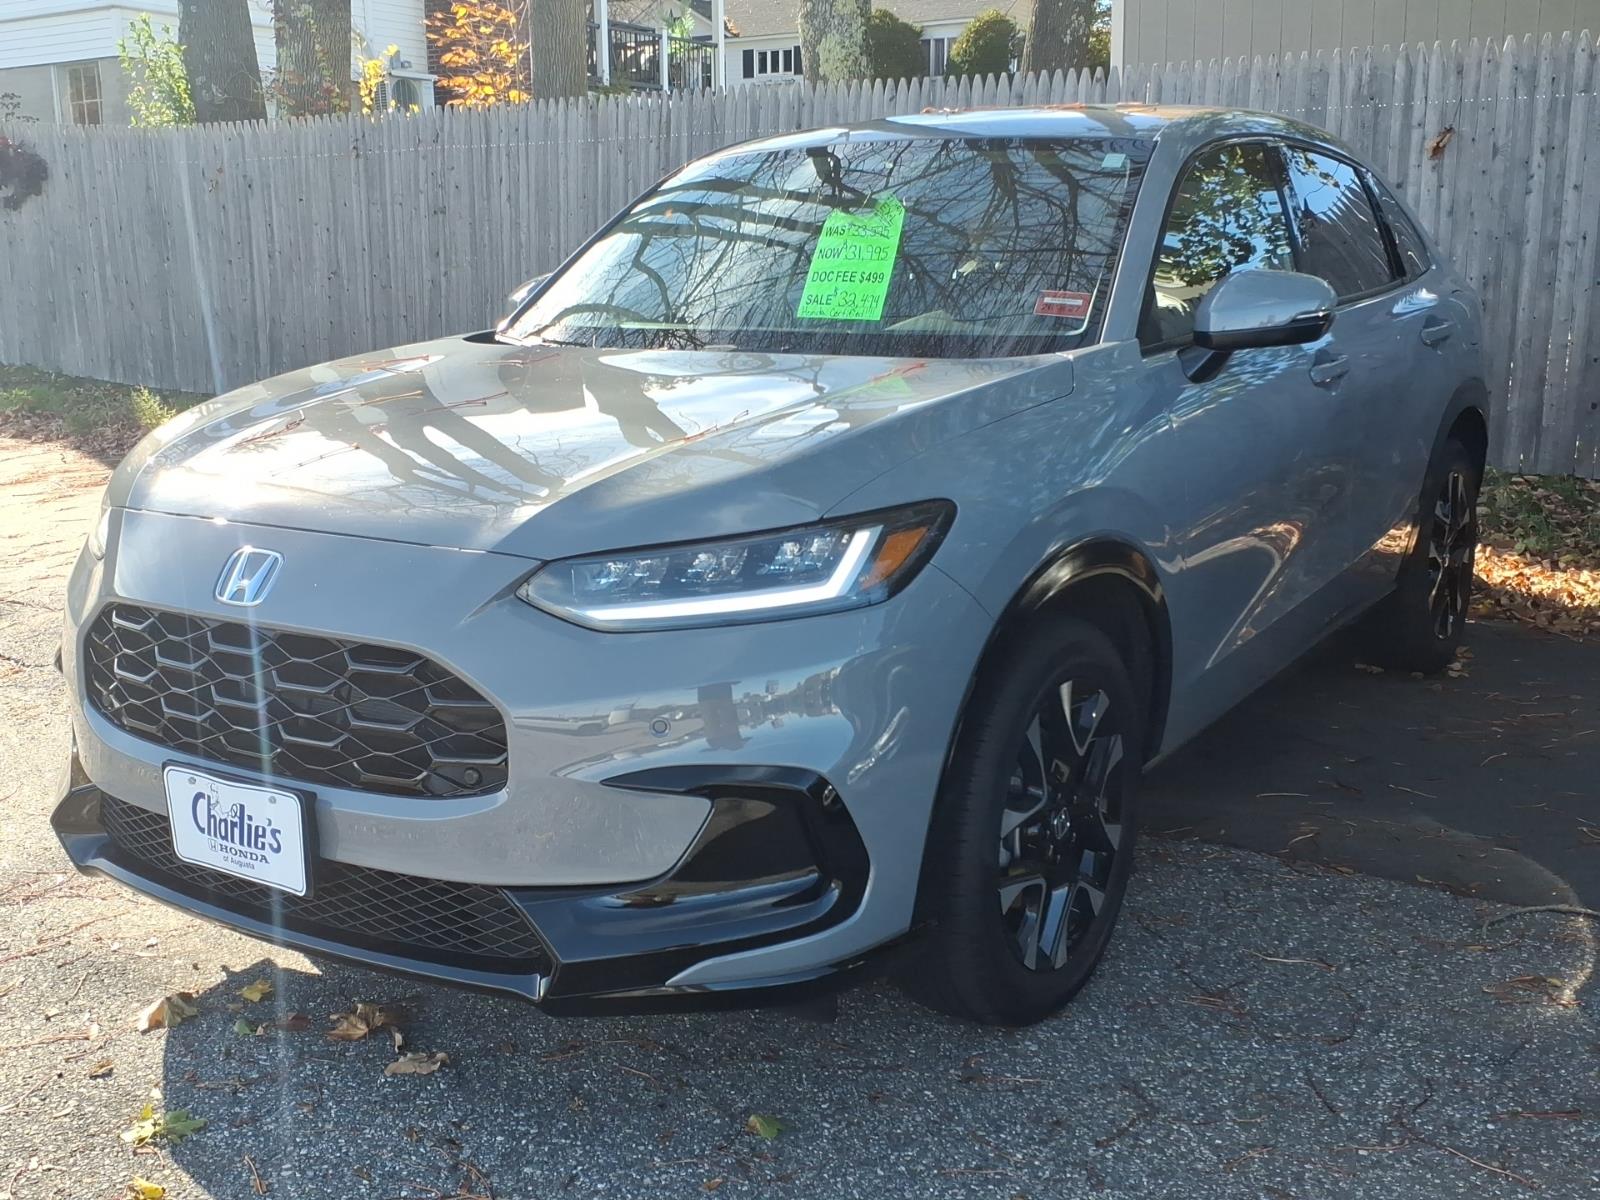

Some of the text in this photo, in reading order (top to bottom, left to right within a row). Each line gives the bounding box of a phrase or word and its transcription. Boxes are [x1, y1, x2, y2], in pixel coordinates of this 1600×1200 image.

[825, 225, 846, 238] WAS
[817, 246, 843, 260] NOW
[811, 271, 885, 284] DOC FEE $499
[805, 294, 832, 305] SALE
[191, 791, 282, 854] Charlie's
[219, 843, 271, 864] HONDA
[230, 857, 256, 870] Augusta
